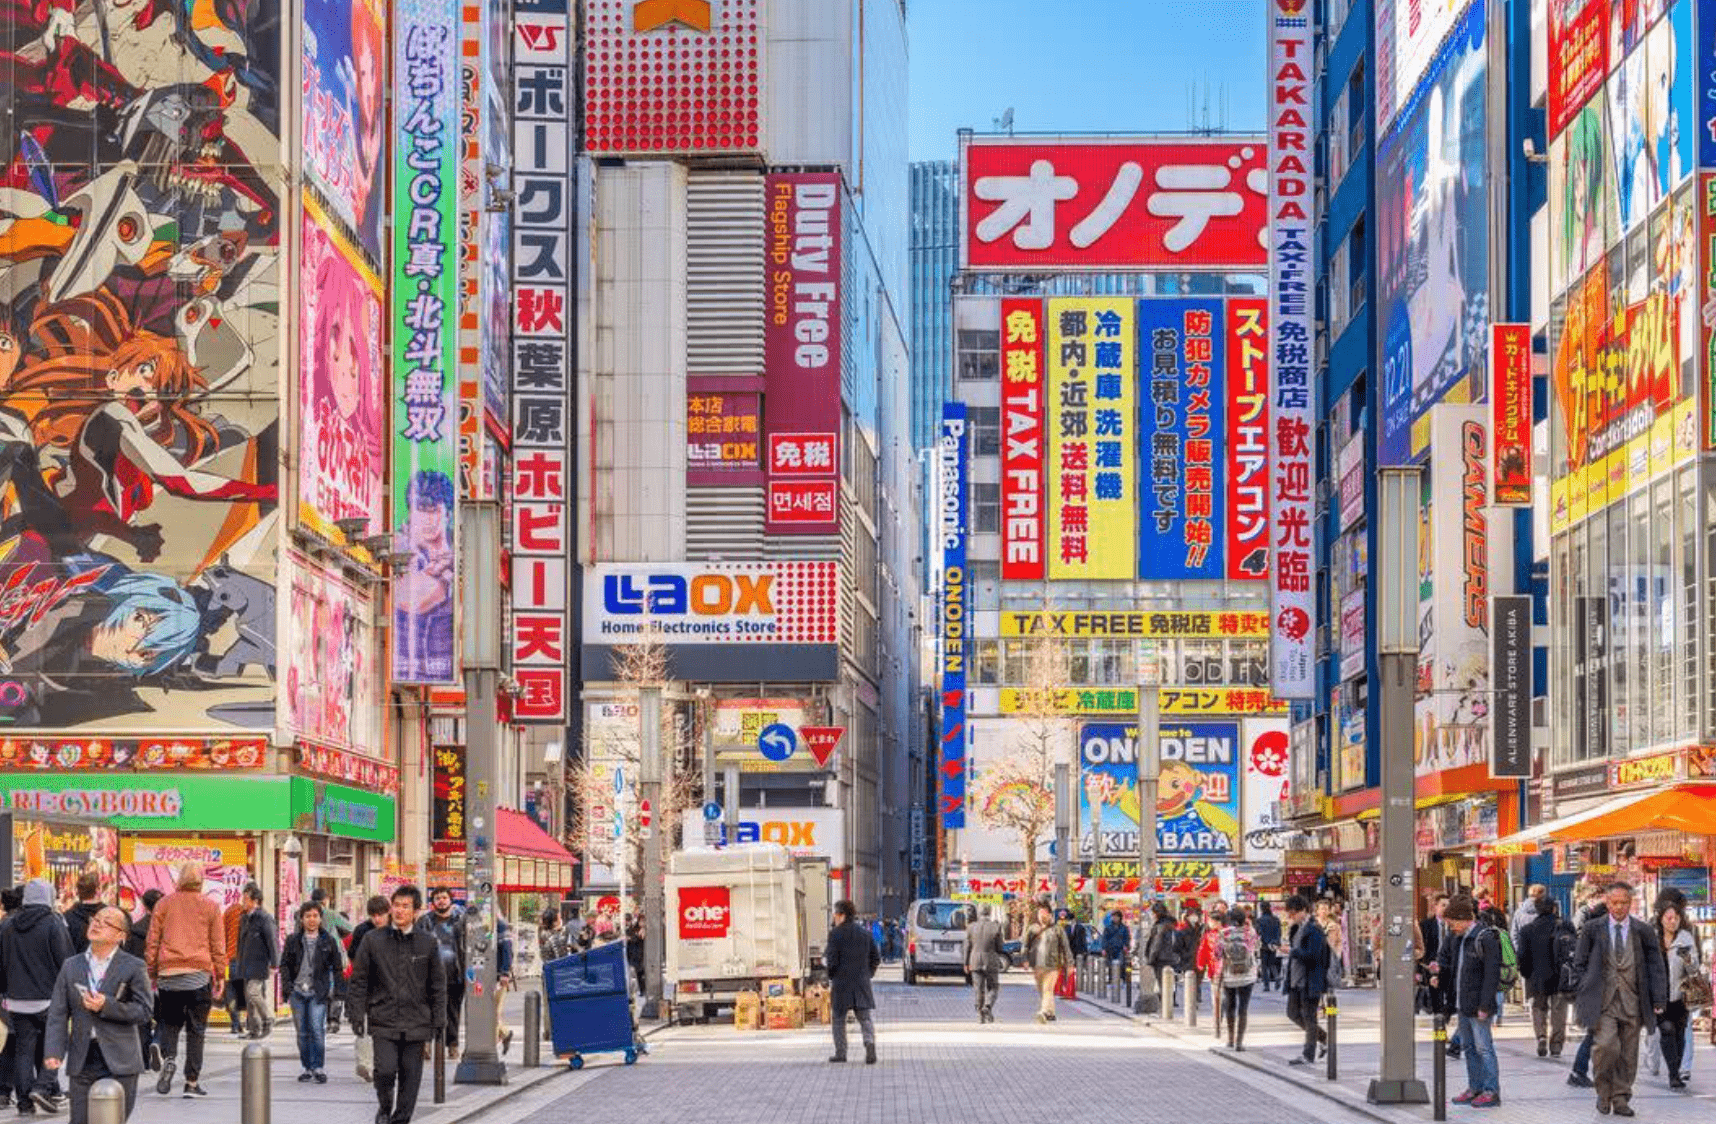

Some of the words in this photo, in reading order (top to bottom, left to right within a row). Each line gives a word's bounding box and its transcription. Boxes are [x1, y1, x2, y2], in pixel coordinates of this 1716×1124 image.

[1276, 39, 1307, 219] TAKARADA
[770, 183, 792, 265] Flagship
[791, 183, 836, 273] Duty
[974, 146, 1269, 253] オノデ
[773, 272, 792, 326] Store
[795, 282, 836, 368] Free
[1006, 309, 1038, 383] 免税
[1094, 310, 1122, 400] 冷蔵庫
[1276, 321, 1309, 409] 免税商店
[774, 441, 831, 468] 免税
[1007, 389, 1038, 460] TAX
[1094, 408, 1122, 500] 洗濯機
[1152, 329, 1179, 531] お見積り無料です
[773, 491, 832, 513] 면세점
[943, 418, 965, 550] Panasonic
[1007, 469, 1038, 564] FREE
[601, 620, 644, 634] Home
[650, 620, 731, 634] Electronics
[736, 620, 776, 634] Store
[945, 566, 963, 673] ONODEN
[1014, 614, 1067, 633] TAX
[1074, 614, 1143, 633] FREE
[1150, 614, 1211, 633] 免税店
[1508, 609, 1518, 646] AKIBA
[1159, 692, 1219, 709] アコン
[1508, 652, 1518, 692] STORE
[1085, 737, 1231, 763] ONDEN
[1508, 694, 1518, 764] ALIENWARE
